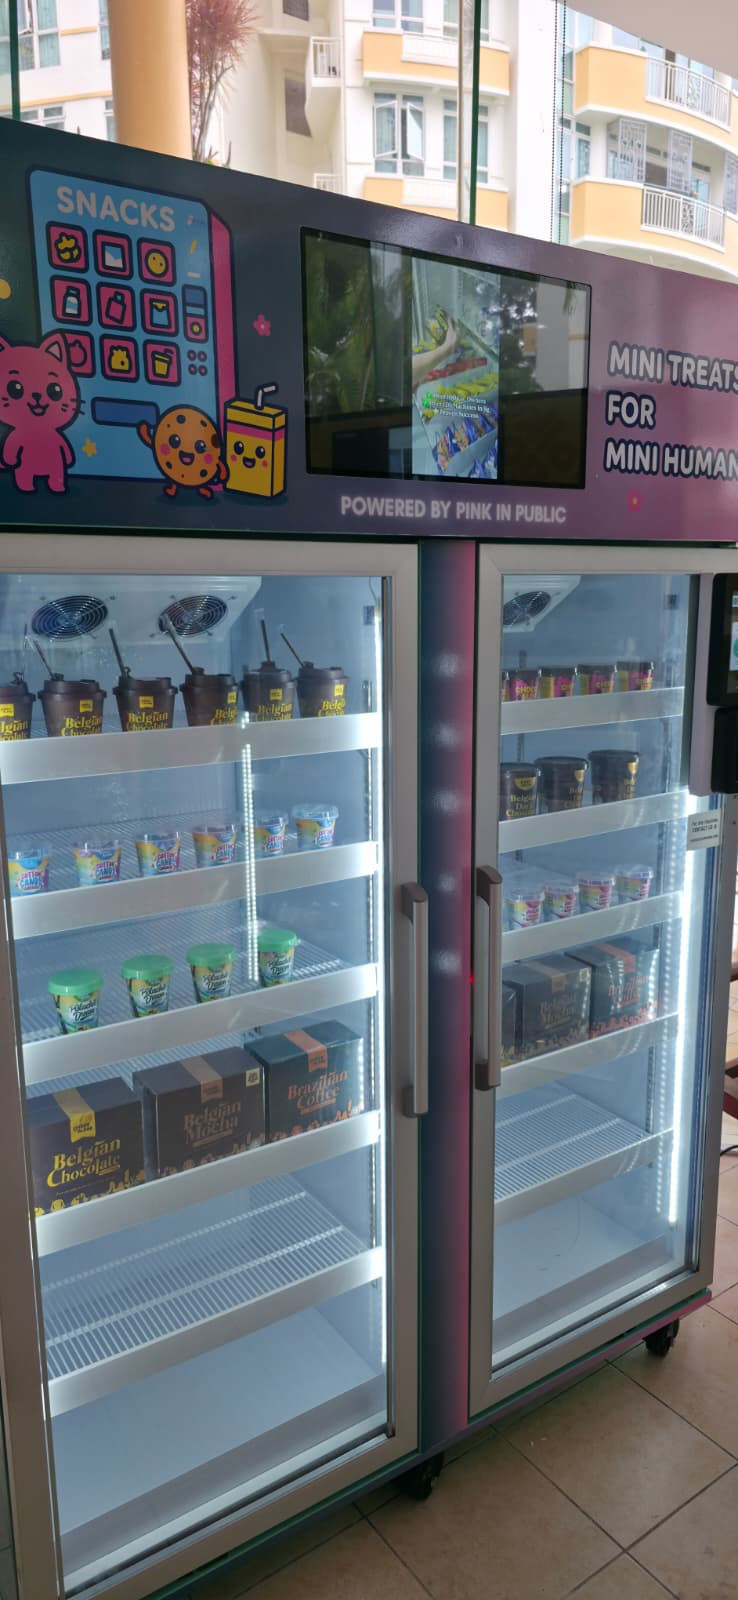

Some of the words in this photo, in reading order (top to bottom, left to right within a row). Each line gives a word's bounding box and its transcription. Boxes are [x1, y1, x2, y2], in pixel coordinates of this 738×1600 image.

[56, 186, 176, 232] SNACKS
[607, 343, 663, 381] MINI
[606, 393, 655, 427] FOR
[604, 440, 659, 472] MINI
[340, 495, 426, 518] POWERED
[431, 500, 451, 519] BY
[456, 502, 492, 521] PINK
[496, 504, 511, 521] IN
[515, 505, 567, 523] PUBLIC
[128, 711, 168, 728] Belgian
[288, 1071, 347, 1101] Brazilian
[296, 1086, 340, 1112] Coffee
[183, 1102, 241, 1129] Belgian
[185, 1114, 239, 1145] Mocha
[53, 1139, 121, 1171] Belgian
[47, 1154, 121, 1188] Chocolate
